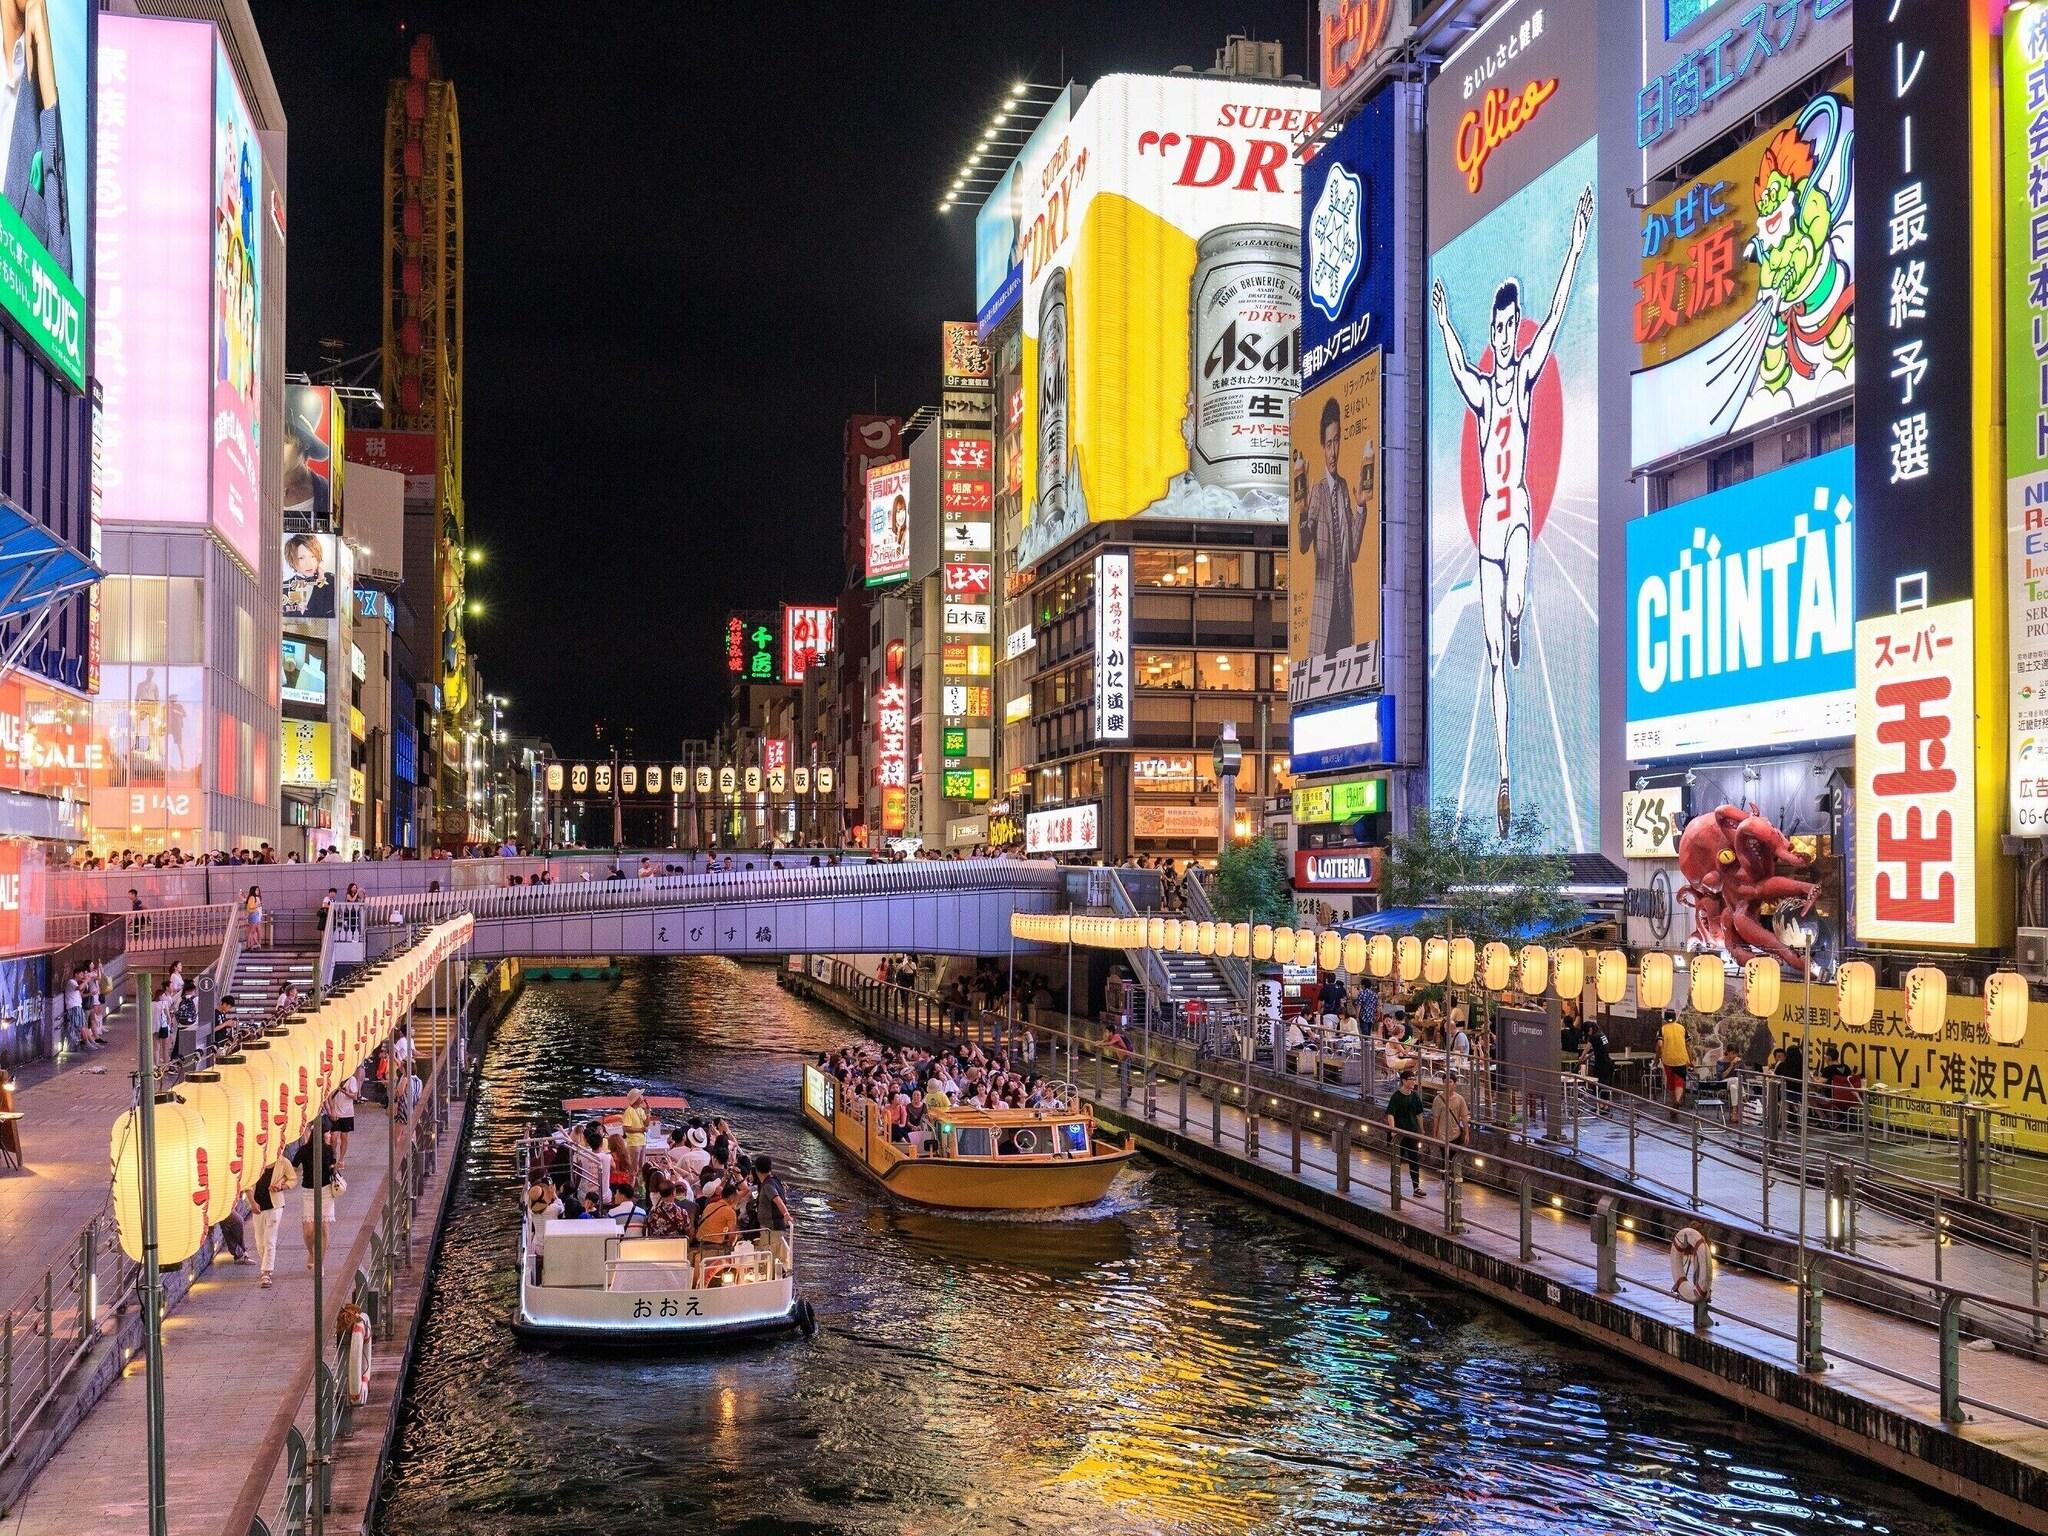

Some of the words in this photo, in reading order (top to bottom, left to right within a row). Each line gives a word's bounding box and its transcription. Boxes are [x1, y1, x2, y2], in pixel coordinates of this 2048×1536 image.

[1463, 8, 1544, 99] おいしさと健康
[1637, 0, 1851, 149] 日商エステ
[1456, 78, 1559, 193] Glico
[1641, 180, 1727, 258] かぜに
[32, 259, 80, 366] サロンパス
[1218, 285, 1239, 308] ASAHI
[1240, 276, 1286, 290] BREWERIES
[1633, 220, 1737, 344] 改源
[1302, 312, 1370, 378] 雪印メグミルク
[1212, 374, 1301, 390] 洗練されたクリアな味
[1248, 394, 1284, 418] 生
[1343, 365, 1378, 398] リラックスが
[1251, 462, 1282, 475] 350ml
[1495, 407, 1514, 522] グリコ
[947, 610, 987, 625] 白木屋
[1108, 583, 1123, 642] 本場の味
[1637, 487, 1853, 693] CHINTAI
[1875, 624, 1953, 669] スーパー
[1106, 649, 1124, 732] かに道楽
[1873, 676, 1957, 923] 玉出
[1318, 857, 1367, 879] LOTTERIA
[656, 926, 773, 943] えびす橋
[633, 1296, 703, 1318] おおえ
